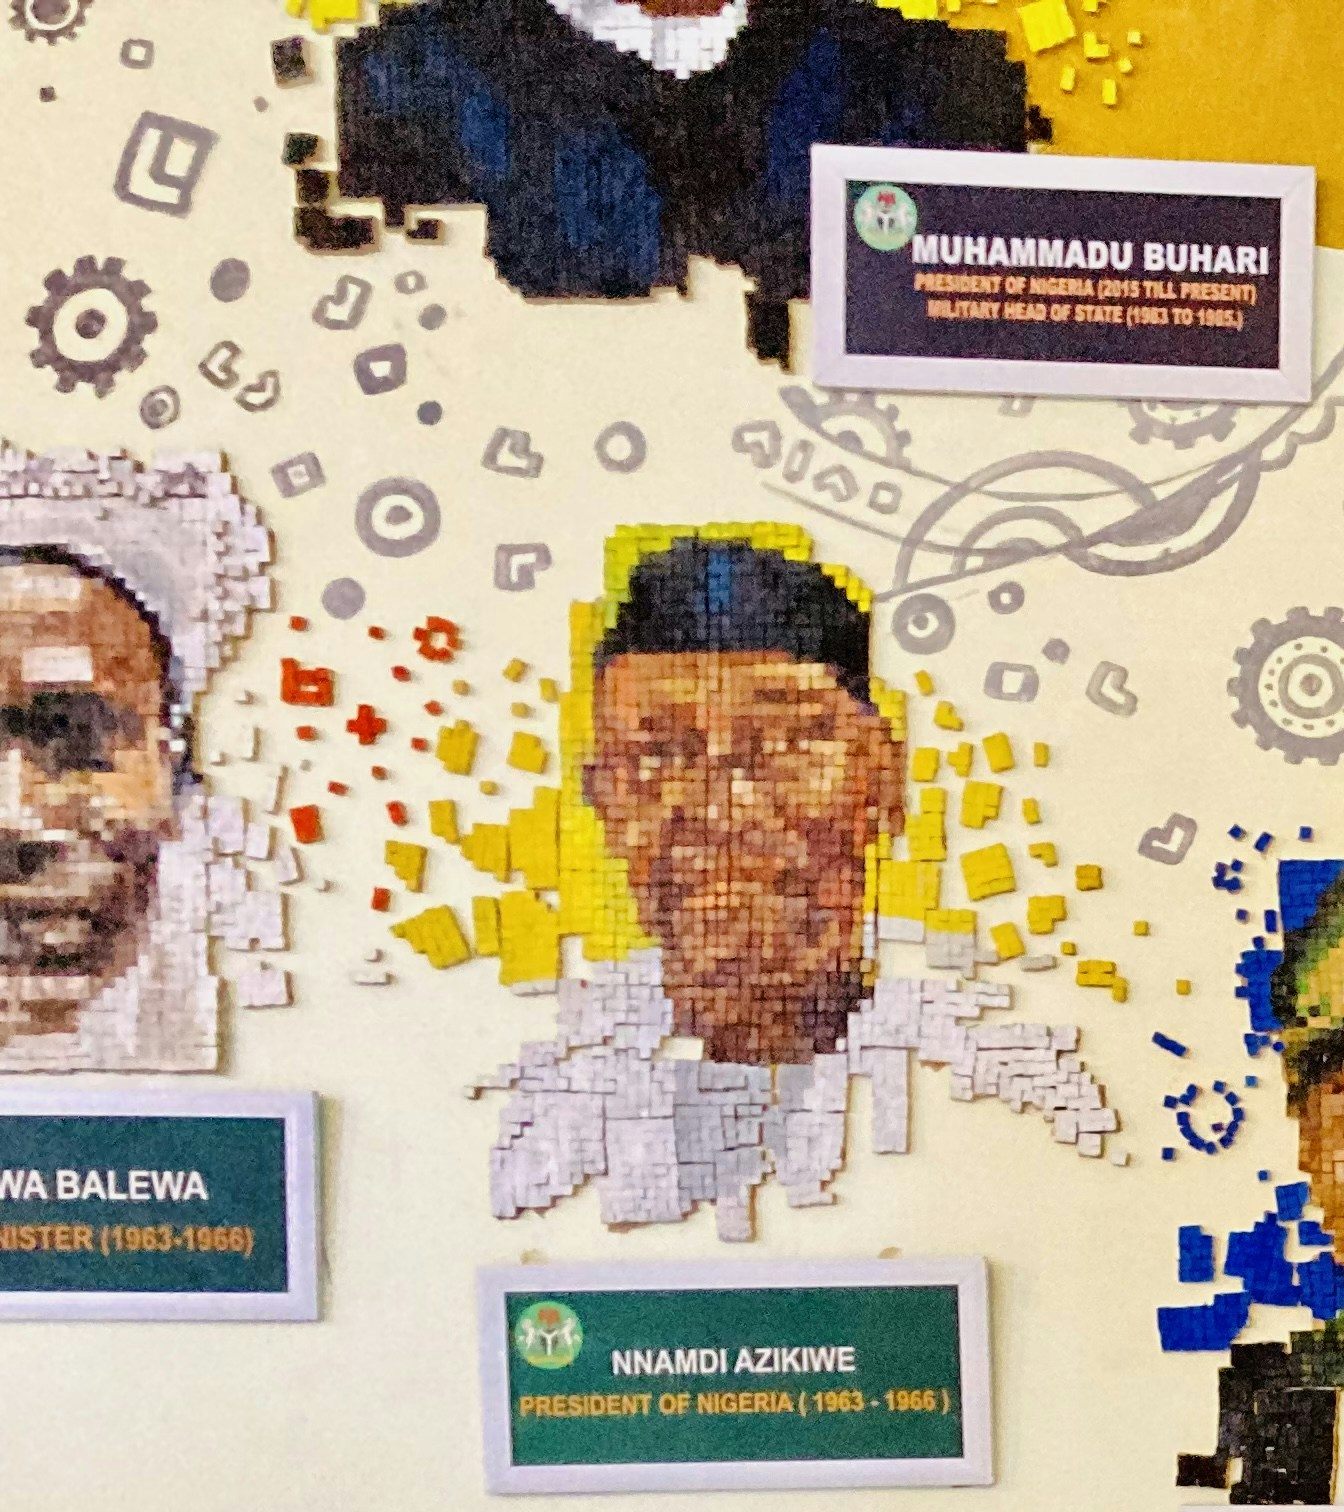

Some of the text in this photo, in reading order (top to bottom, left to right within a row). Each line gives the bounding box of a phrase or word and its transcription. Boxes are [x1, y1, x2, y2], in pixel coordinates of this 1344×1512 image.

[912, 234, 1269, 275] MUHAMMADU BUHARI
[914, 272, 1001, 294] PRESIDENT
[1004, 275, 1027, 295] OF
[1029, 277, 1095, 297] NIGERIA
[1143, 281, 1177, 299] TILL
[927, 299, 1000, 320] MILITARY
[1003, 301, 1047, 321] HEAD
[1050, 303, 1072, 322] OF
[1074, 304, 1124, 324] STATE
[1171, 307, 1194, 326] TO
[56, 1169, 209, 1200] BALEWA
[611, 1346, 856, 1376] NNAMDI AZIKIWE
[519, 1393, 652, 1417] PRESIDENT
[658, 1392, 691, 1415] OF
[696, 1390, 794, 1415] NIGERIA
